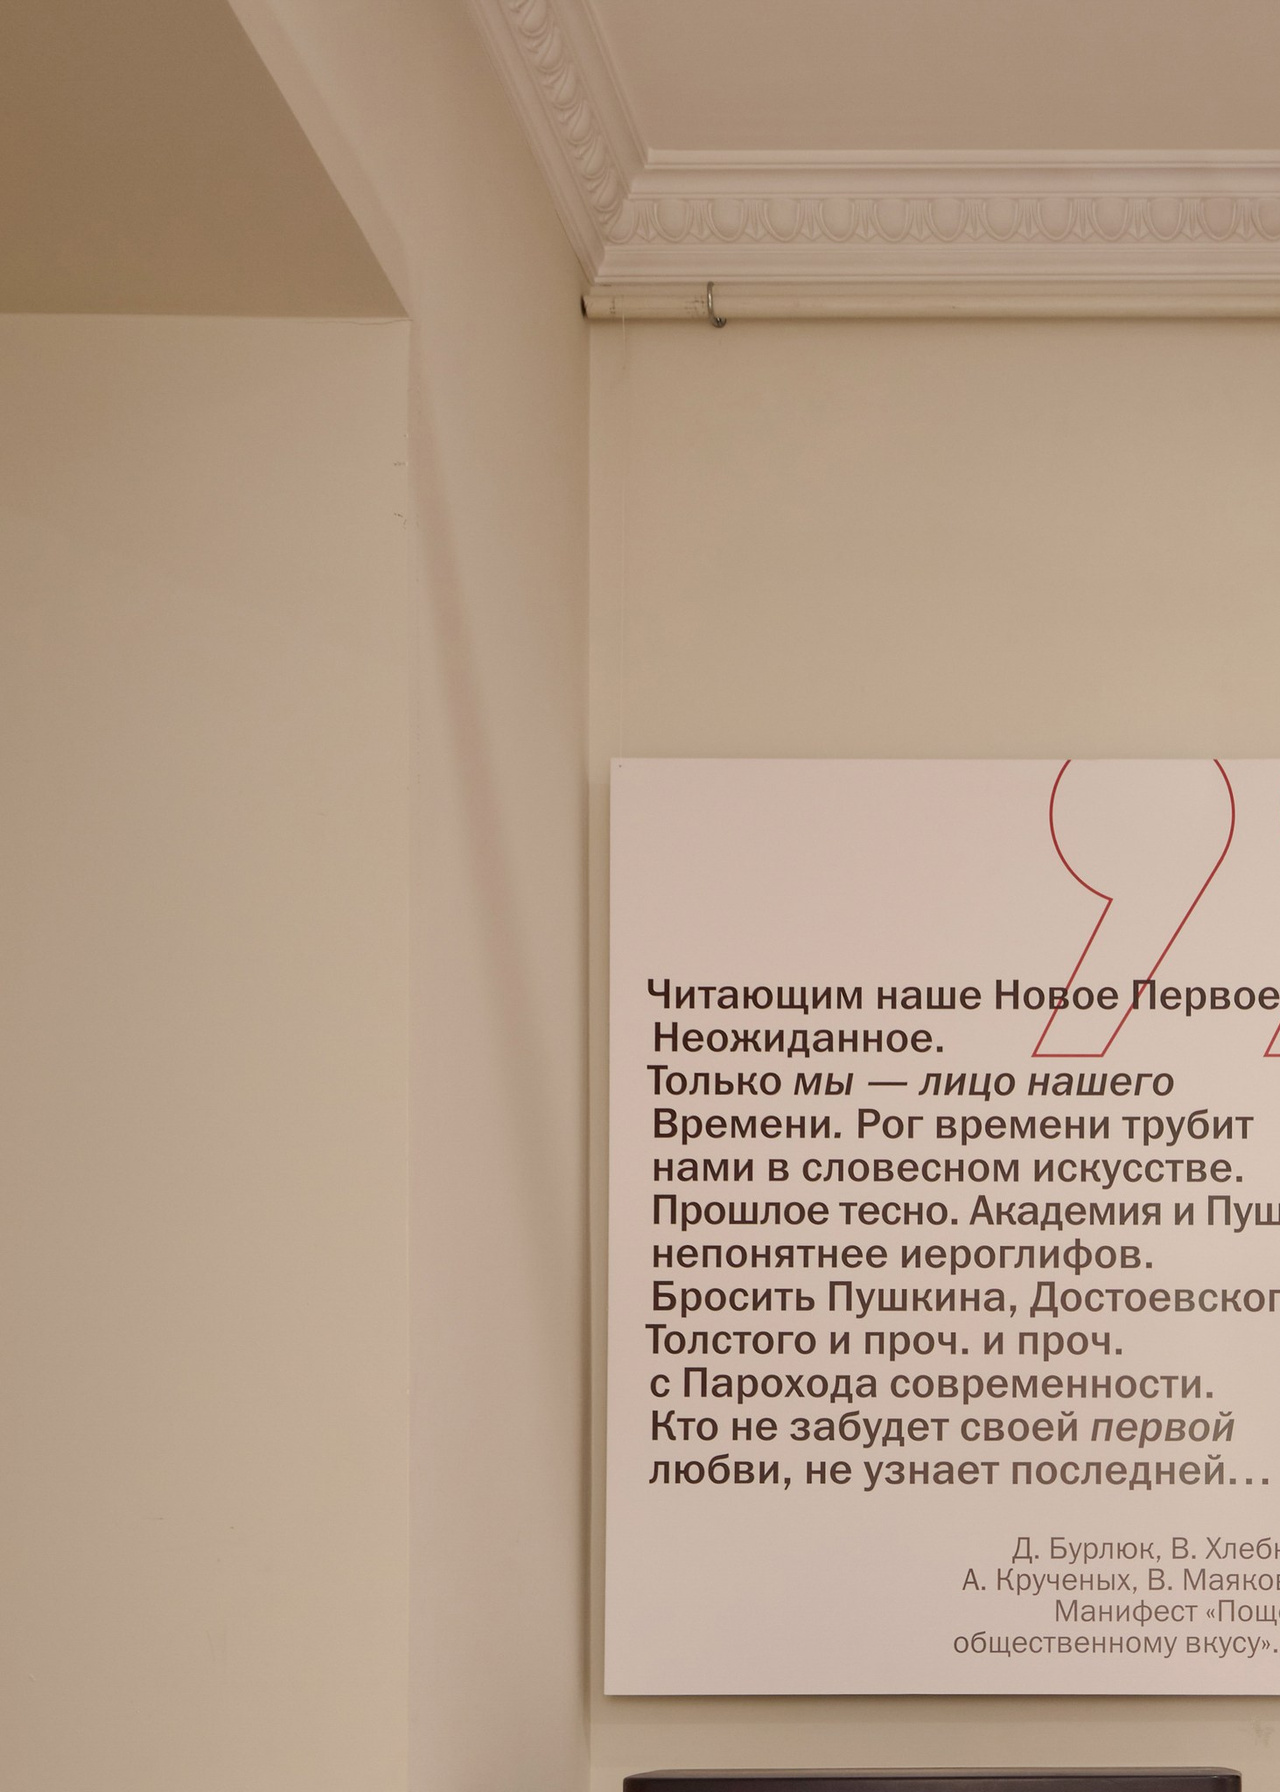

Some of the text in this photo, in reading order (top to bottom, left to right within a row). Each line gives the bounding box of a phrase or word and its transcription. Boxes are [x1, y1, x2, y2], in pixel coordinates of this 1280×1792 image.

[647, 978, 1280, 1017] Читающим наше Новое Первое
[654, 1021, 943, 1059] Неожиданное.
[646, 1064, 782, 1096] Только
[793, 1072, 854, 1096] мы
[917, 1072, 1016, 1102] лицо
[1027, 1072, 1175, 1097] нашего
[653, 1107, 1255, 1147] Времени. Рог времени трубит
[653, 1157, 1243, 1190] нами в словесном искусстве.
[653, 1193, 830, 1232] Прошлое
[838, 1201, 958, 1226] тесно.
[969, 1194, 1161, 1231] Академия
[1174, 1202, 1194, 1226] и
[653, 1237, 1153, 1276] непонятнее иероглифов.
[652, 1280, 815, 1319] Бросить
[829, 1280, 1017, 1319] Пушкина,
[1011, 1536, 1040, 1565] Д.
[1050, 1536, 1161, 1565] Бурлюк,
[1172, 1536, 1197, 1560] В.
[953, 1630, 1178, 1659] общественному
[1186, 1635, 1278, 1659] вкусу».
